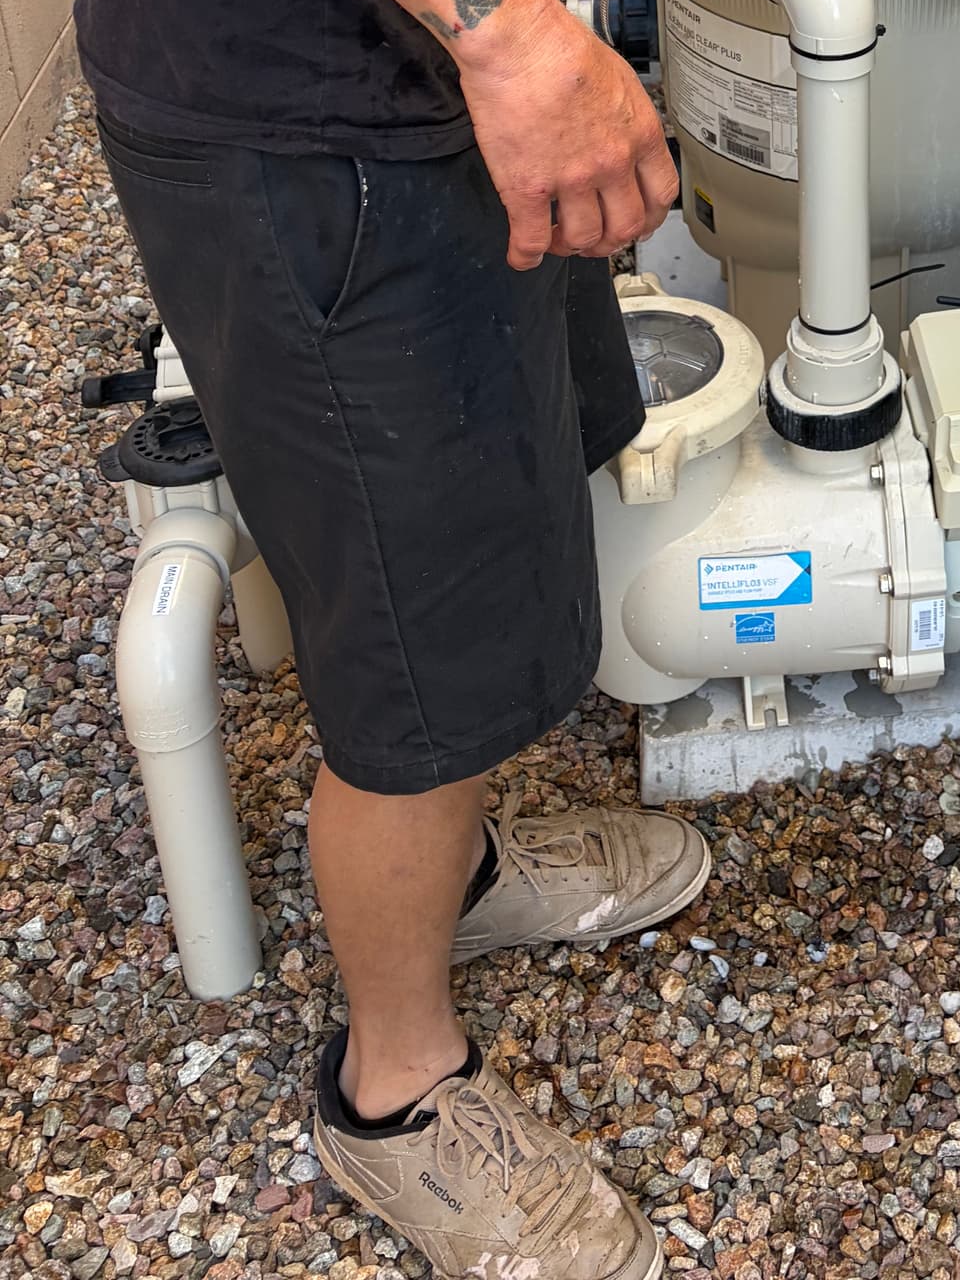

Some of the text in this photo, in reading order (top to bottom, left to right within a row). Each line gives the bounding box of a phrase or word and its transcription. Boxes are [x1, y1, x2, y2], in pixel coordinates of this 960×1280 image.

[721, 47, 742, 63] PLUS
[715, 563, 756, 572] PENTAIR
[156, 566, 178, 614] MAIN DRAIN
[762, 578, 778, 587] VSF
[418, 1171, 465, 1215] Reebok
